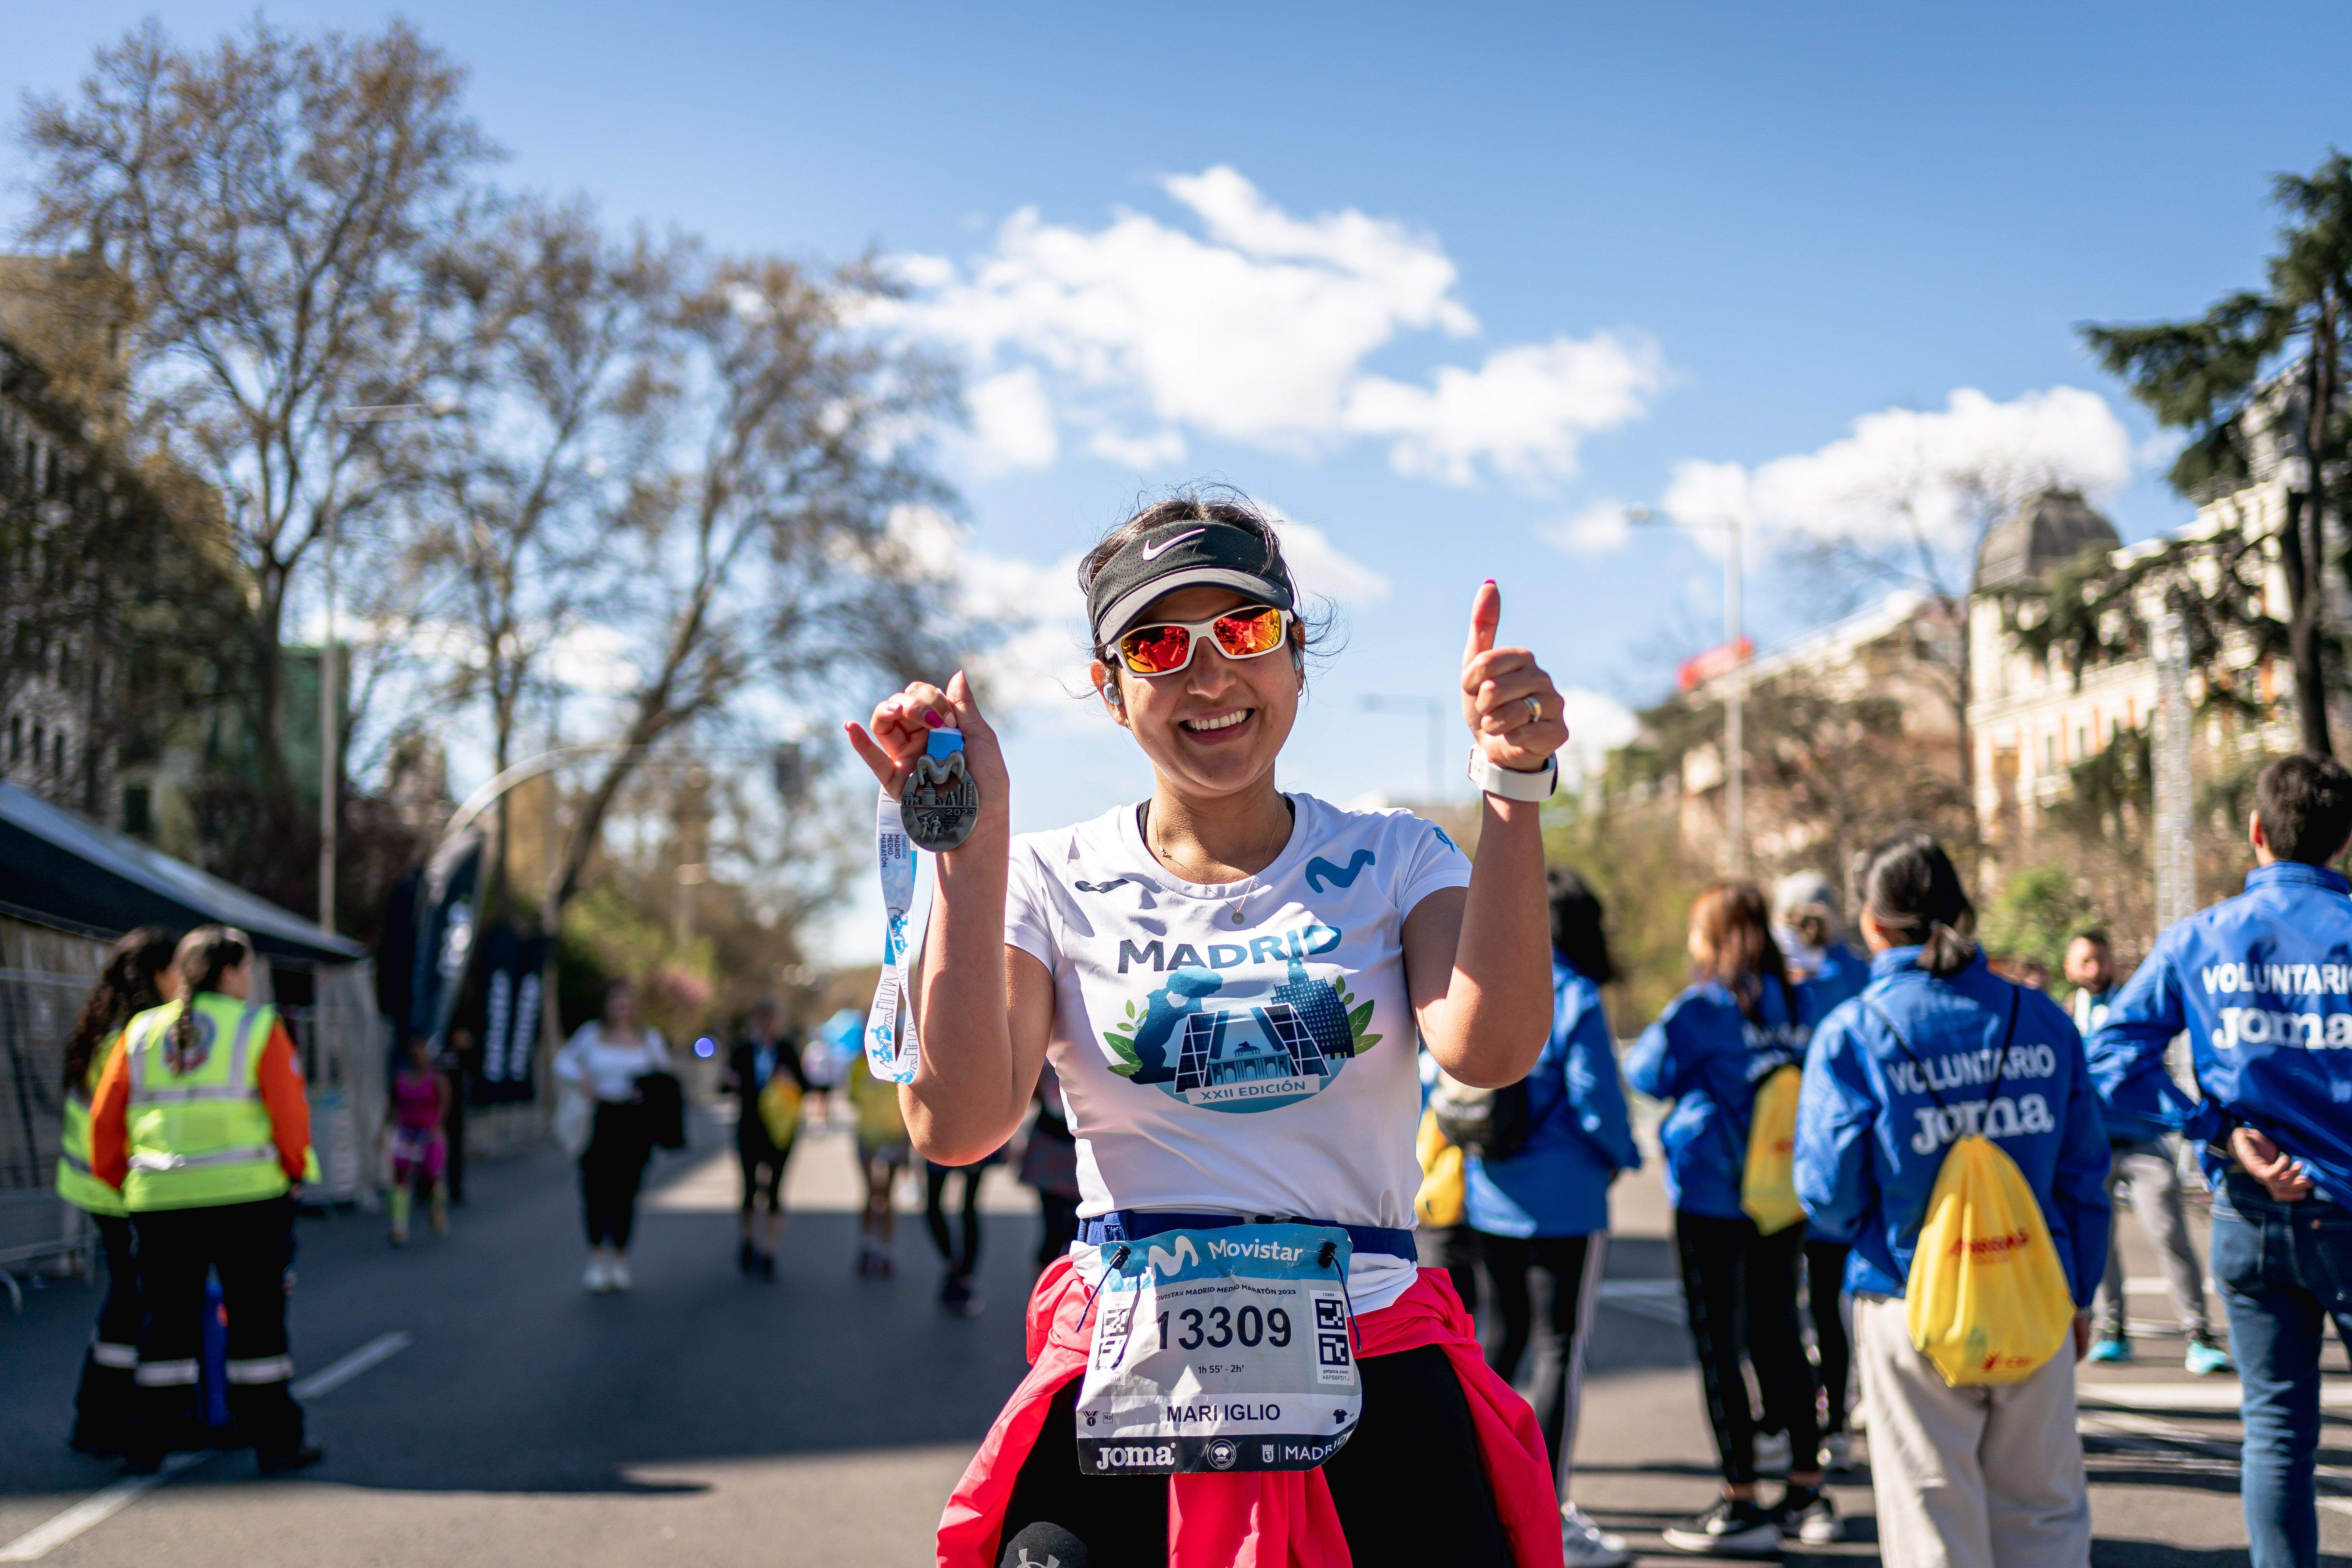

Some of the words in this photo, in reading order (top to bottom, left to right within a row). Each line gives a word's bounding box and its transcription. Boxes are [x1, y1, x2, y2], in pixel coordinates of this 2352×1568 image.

[1118, 925, 1341, 973] MADRID
[2201, 962, 2352, 995] VOLUNTARI
[1200, 1088, 1234, 1100] XXII
[1238, 1080, 1305, 1096] EDICIÓN
[1208, 1238, 1303, 1261] Movistar
[1156, 1290, 1183, 1301] OVISTAR
[1185, 1287, 1215, 1295] MADRID
[1216, 1284, 1240, 1293] MEDIO
[1241, 1284, 1276, 1295] MARATÓN
[1154, 1305, 1292, 1350] 13309
[1198, 1366, 1207, 1374] 1h
[1167, 1405, 1218, 1422] MARI
[1225, 1404, 1281, 1421] IGLIO
[1285, 1434, 1347, 1460] MADRID
